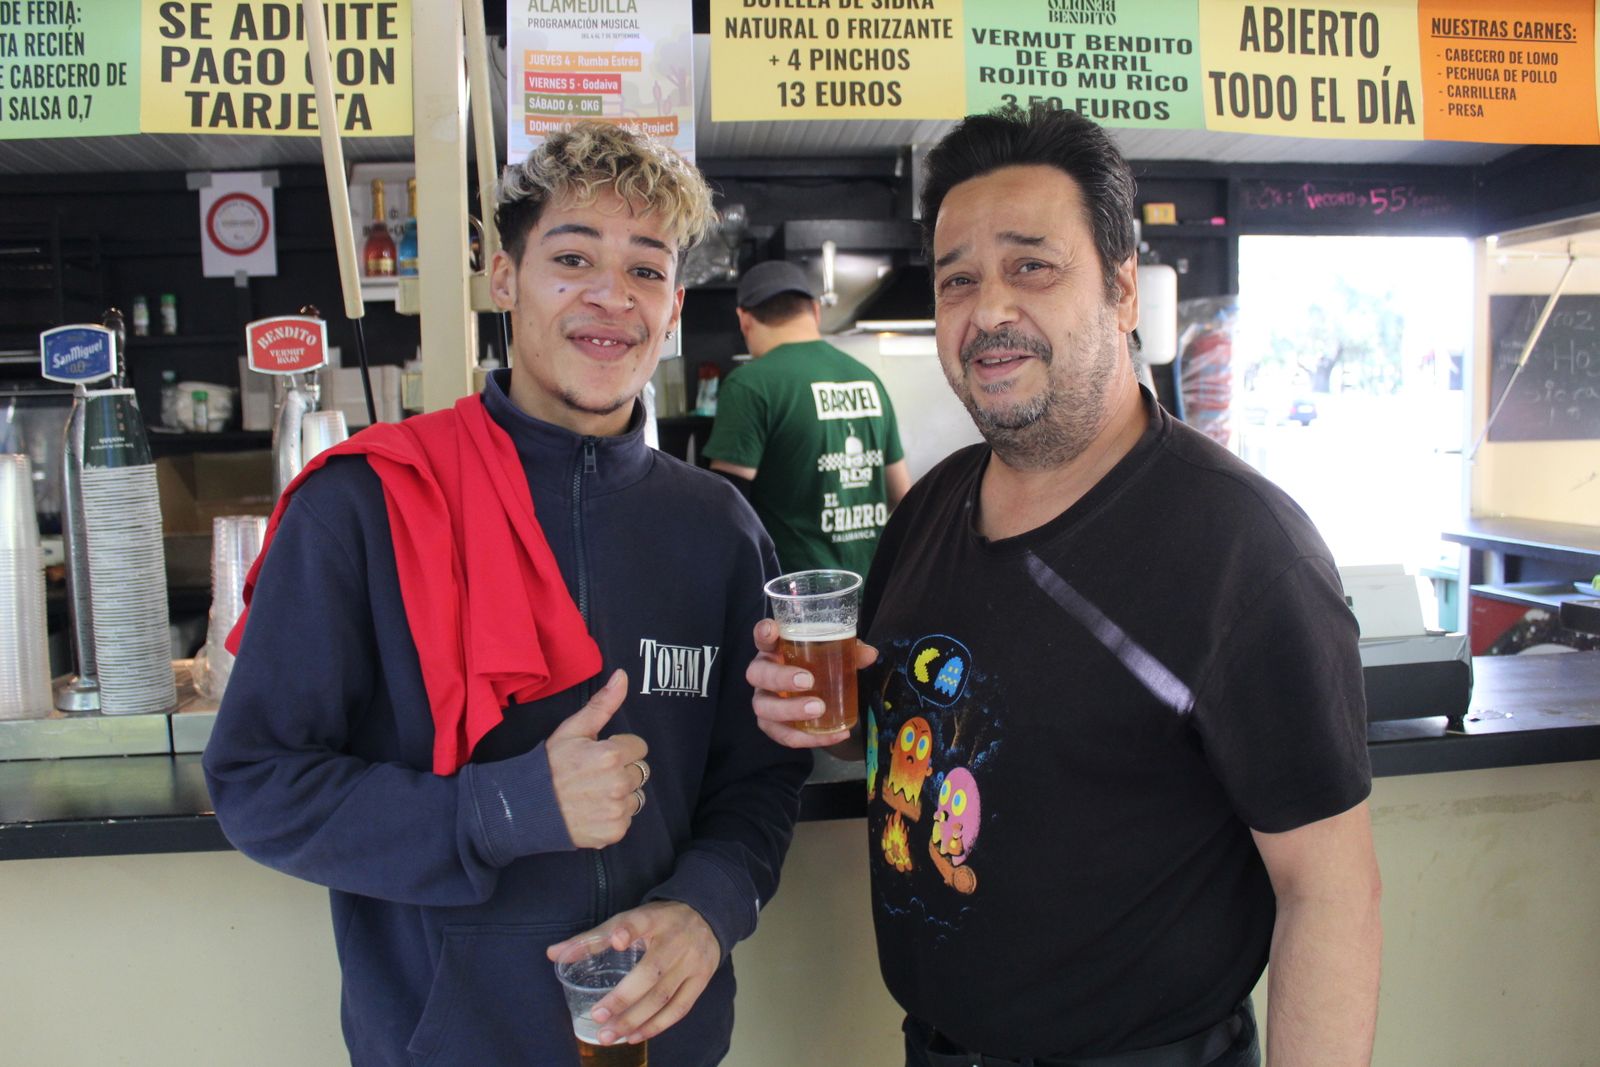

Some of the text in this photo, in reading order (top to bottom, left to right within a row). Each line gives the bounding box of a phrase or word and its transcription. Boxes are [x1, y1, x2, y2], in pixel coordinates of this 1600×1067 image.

[27, 0, 82, 25] FERIA:
[528, 0, 638, 13] ALAMEDILLA
[1048, 10, 1117, 26] BENDITO
[158, 1, 213, 40] SE
[527, 17, 641, 30] PROGRAMACIÓN MUSICAL
[725, 17, 953, 39] NATURAL O FRIZZANTE
[1239, 5, 1380, 59] ABIERTO
[1431, 17, 1577, 40] NUESTRAS CARNES:
[24, 24, 85, 57] RECIÉN
[971, 27, 1193, 55] VERMUT BENDITO
[161, 46, 286, 86] PAGO
[529, 54, 562, 66] JUEVES
[578, 55, 609, 67] Rumba
[787, 48, 802, 71] 4
[809, 48, 911, 71] PINCHOS
[1016, 49, 1153, 73] DE BARRIL
[1445, 47, 1505, 64] CABECERO
[1508, 50, 1524, 65] DE
[1526, 51, 1559, 66] LOMO
[10, 62, 101, 90] CABECERO
[106, 62, 128, 87] DE
[529, 76, 619, 90] VIERNES 5 Godaiva
[979, 66, 1189, 92] ROJITO MU RICO
[1446, 66, 1500, 82] PECHUGA
[1503, 68, 1518, 83] DE
[1521, 70, 1557, 84] POLLO
[529, 95, 566, 111] SÁBADO
[567, 99, 574, 111] 6
[777, 80, 902, 107] 13 EUROS
[1208, 65, 1416, 125] TODO EL DÍA
[1447, 84, 1517, 101] CARRILLERA
[9, 95, 62, 121] SALSA
[68, 94, 93, 123] 0,7
[1075, 97, 1170, 121] EUROS
[1448, 102, 1484, 118] PRESA
[529, 119, 572, 133] DOMINO
[257, 326, 318, 350] BENDITO
[818, 387, 878, 413] BARVEL
[821, 502, 888, 533] CHARRO
[640, 638, 720, 697] TOMMY
